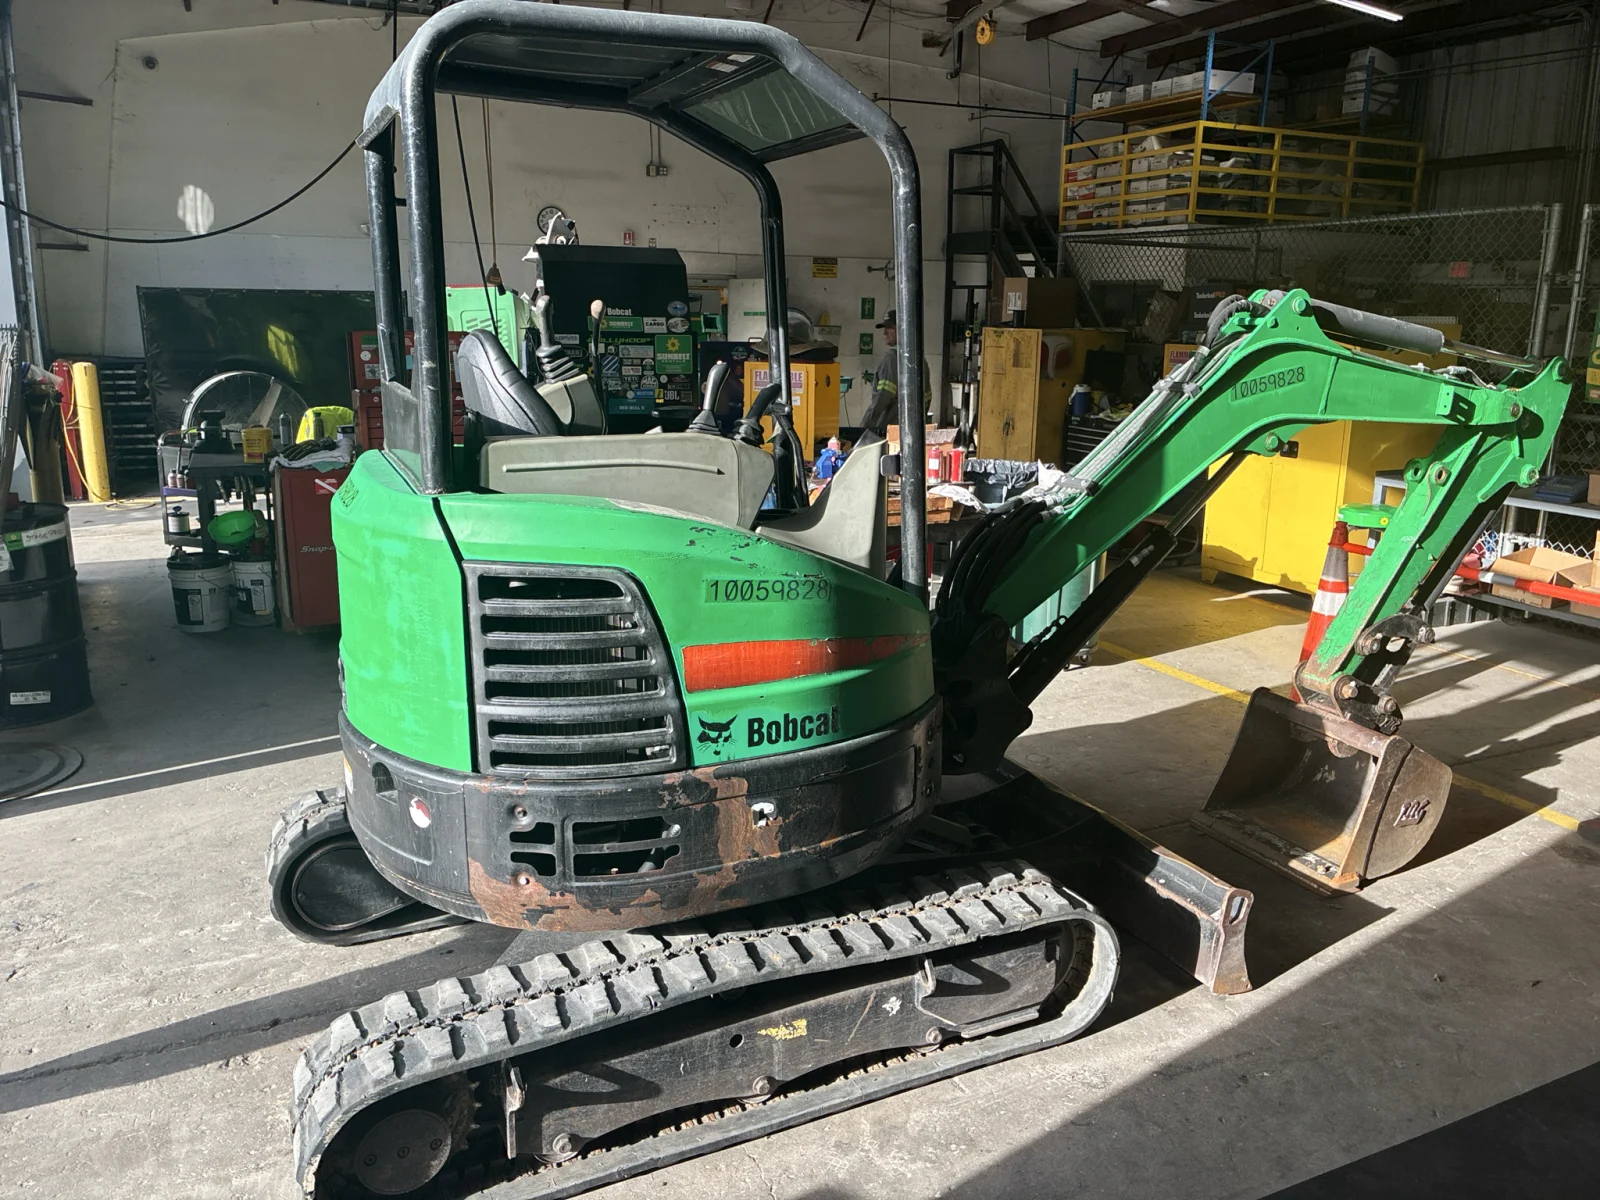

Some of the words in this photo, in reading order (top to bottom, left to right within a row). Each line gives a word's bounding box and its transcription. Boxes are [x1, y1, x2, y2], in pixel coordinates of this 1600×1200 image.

[607, 308, 632, 316] Bobcat
[754, 371, 803, 381] FLALE
[1231, 366, 1305, 400] 10059828
[664, 390, 680, 400] JBL
[301, 545, 337, 553] Snap-o
[709, 579, 829, 601] 10059828
[747, 705, 841, 748] Bobcat
